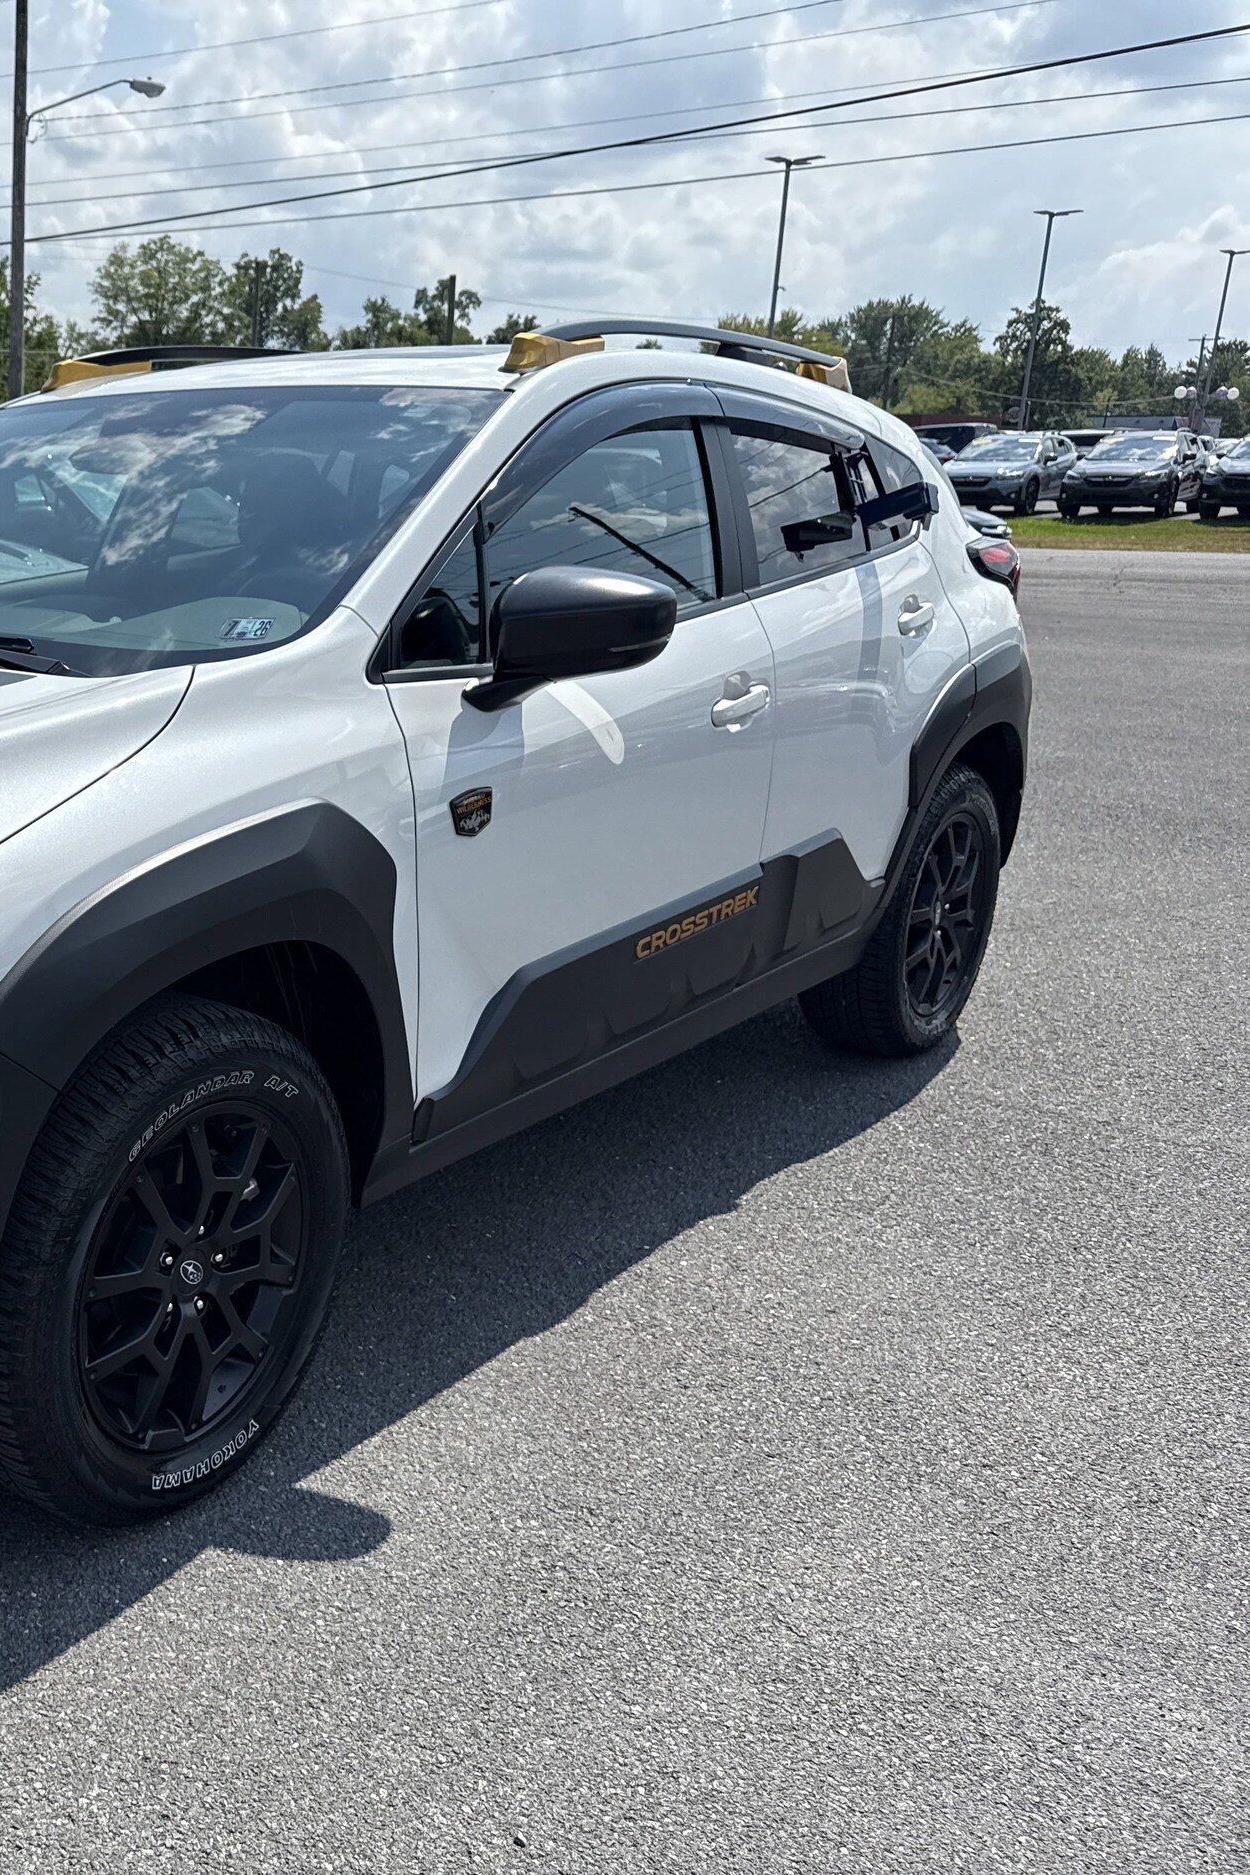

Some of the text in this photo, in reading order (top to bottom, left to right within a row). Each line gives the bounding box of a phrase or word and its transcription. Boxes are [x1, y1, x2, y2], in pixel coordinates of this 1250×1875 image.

[224, 620, 272, 637] 7 26
[636, 885, 759, 959] CROSSTREK
[128, 1069, 299, 1163] GEOLANDAR A/T
[151, 1419, 260, 1491] YOKOHAMA
